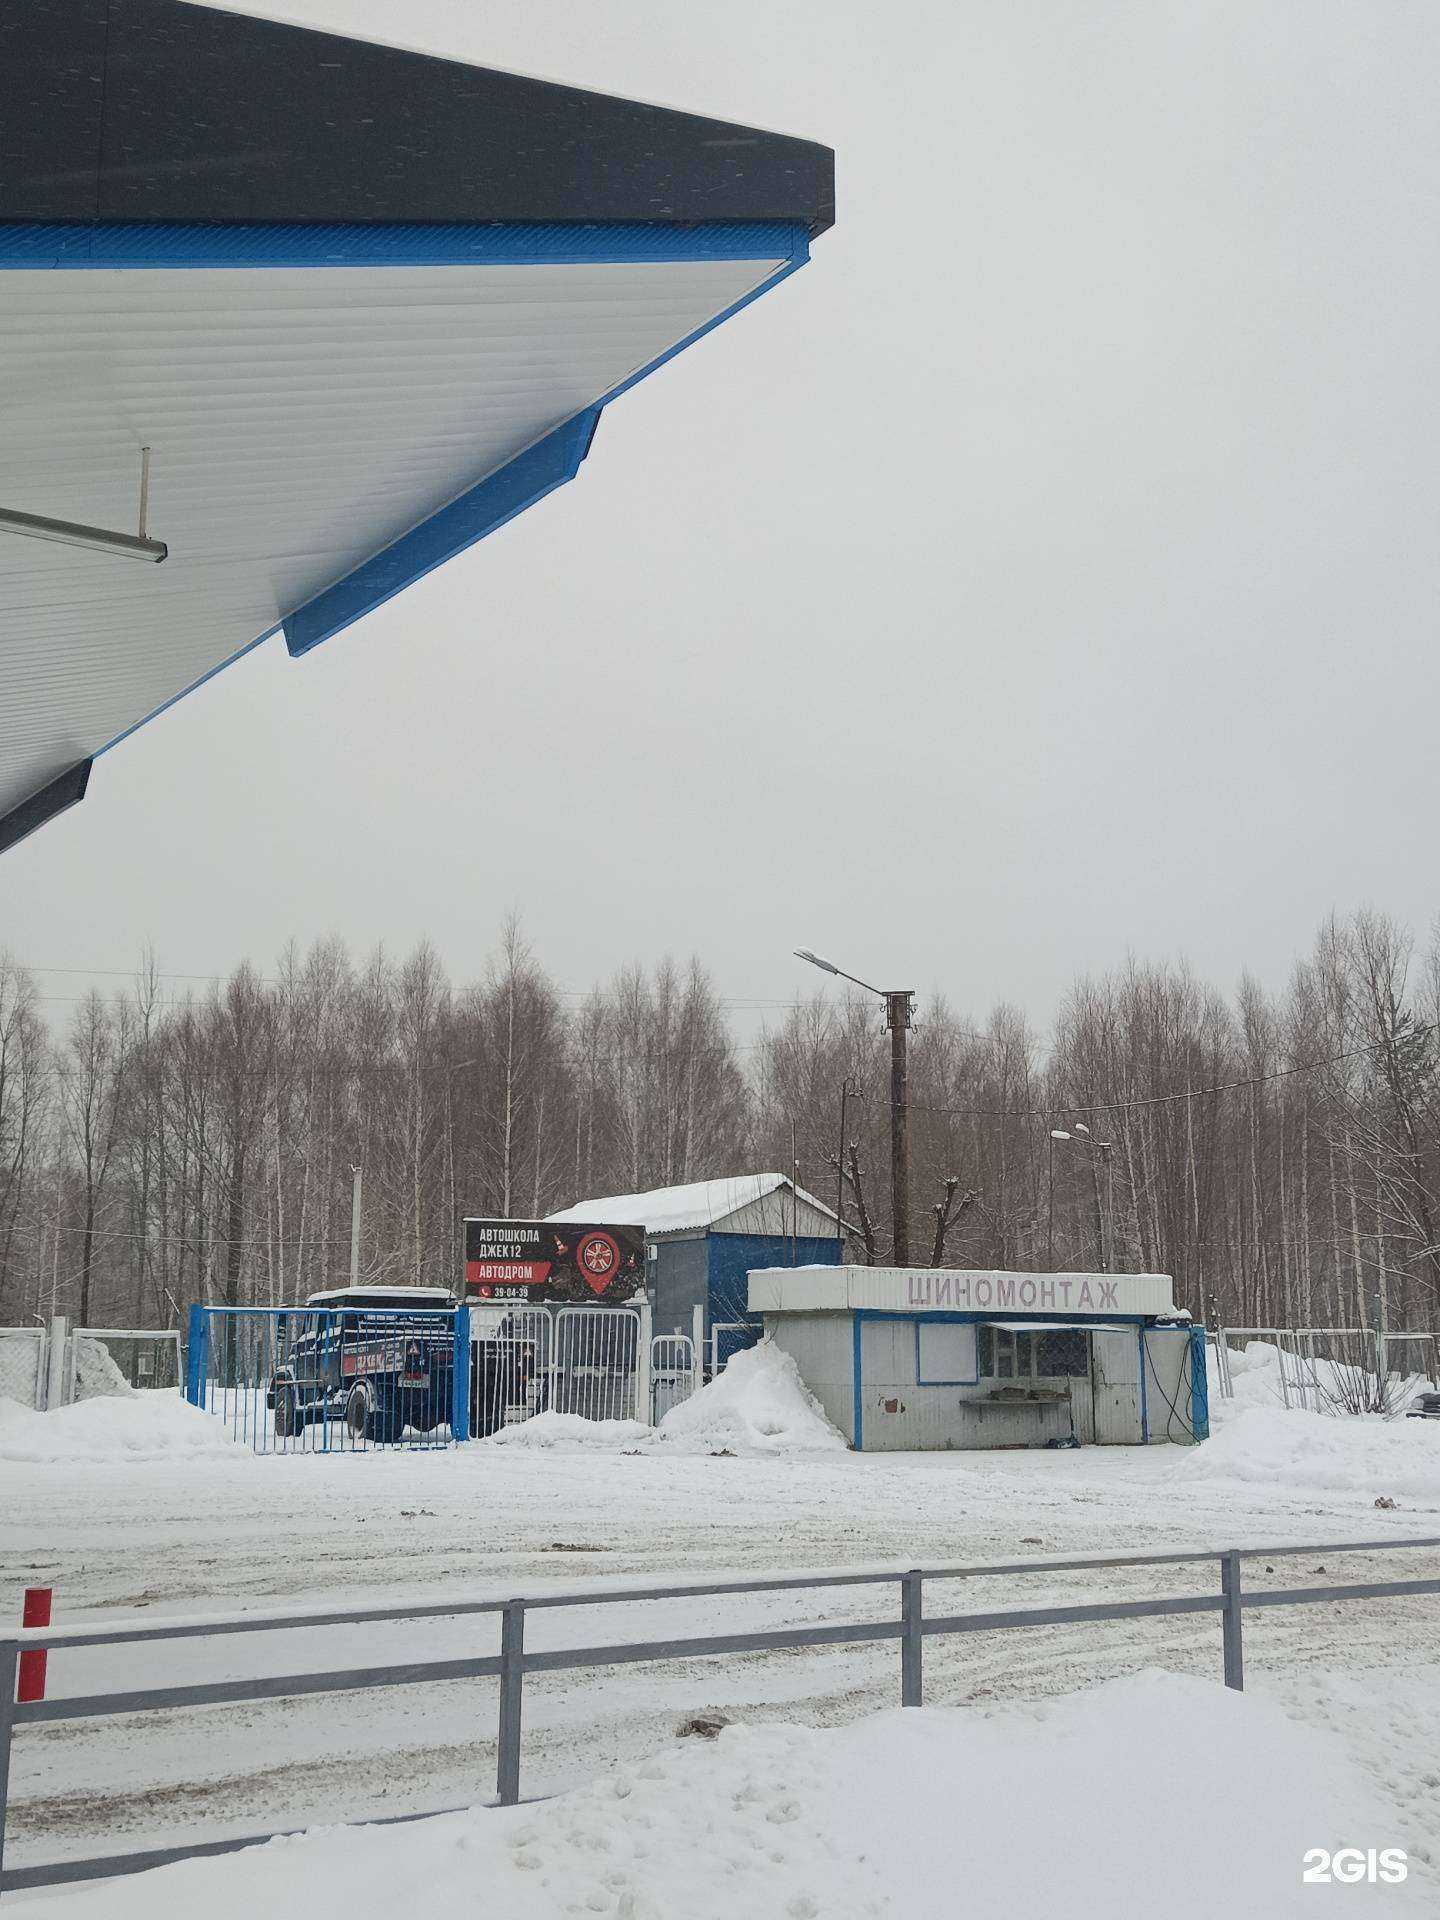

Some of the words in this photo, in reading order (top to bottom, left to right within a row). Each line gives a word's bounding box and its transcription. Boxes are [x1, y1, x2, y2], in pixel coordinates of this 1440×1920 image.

[480, 1229, 540, 1242] АВТОШКОЛА
[479, 1265, 533, 1280] АВТОДРОМ
[907, 1276, 1120, 1309] ШИНОМОНТАЖ
